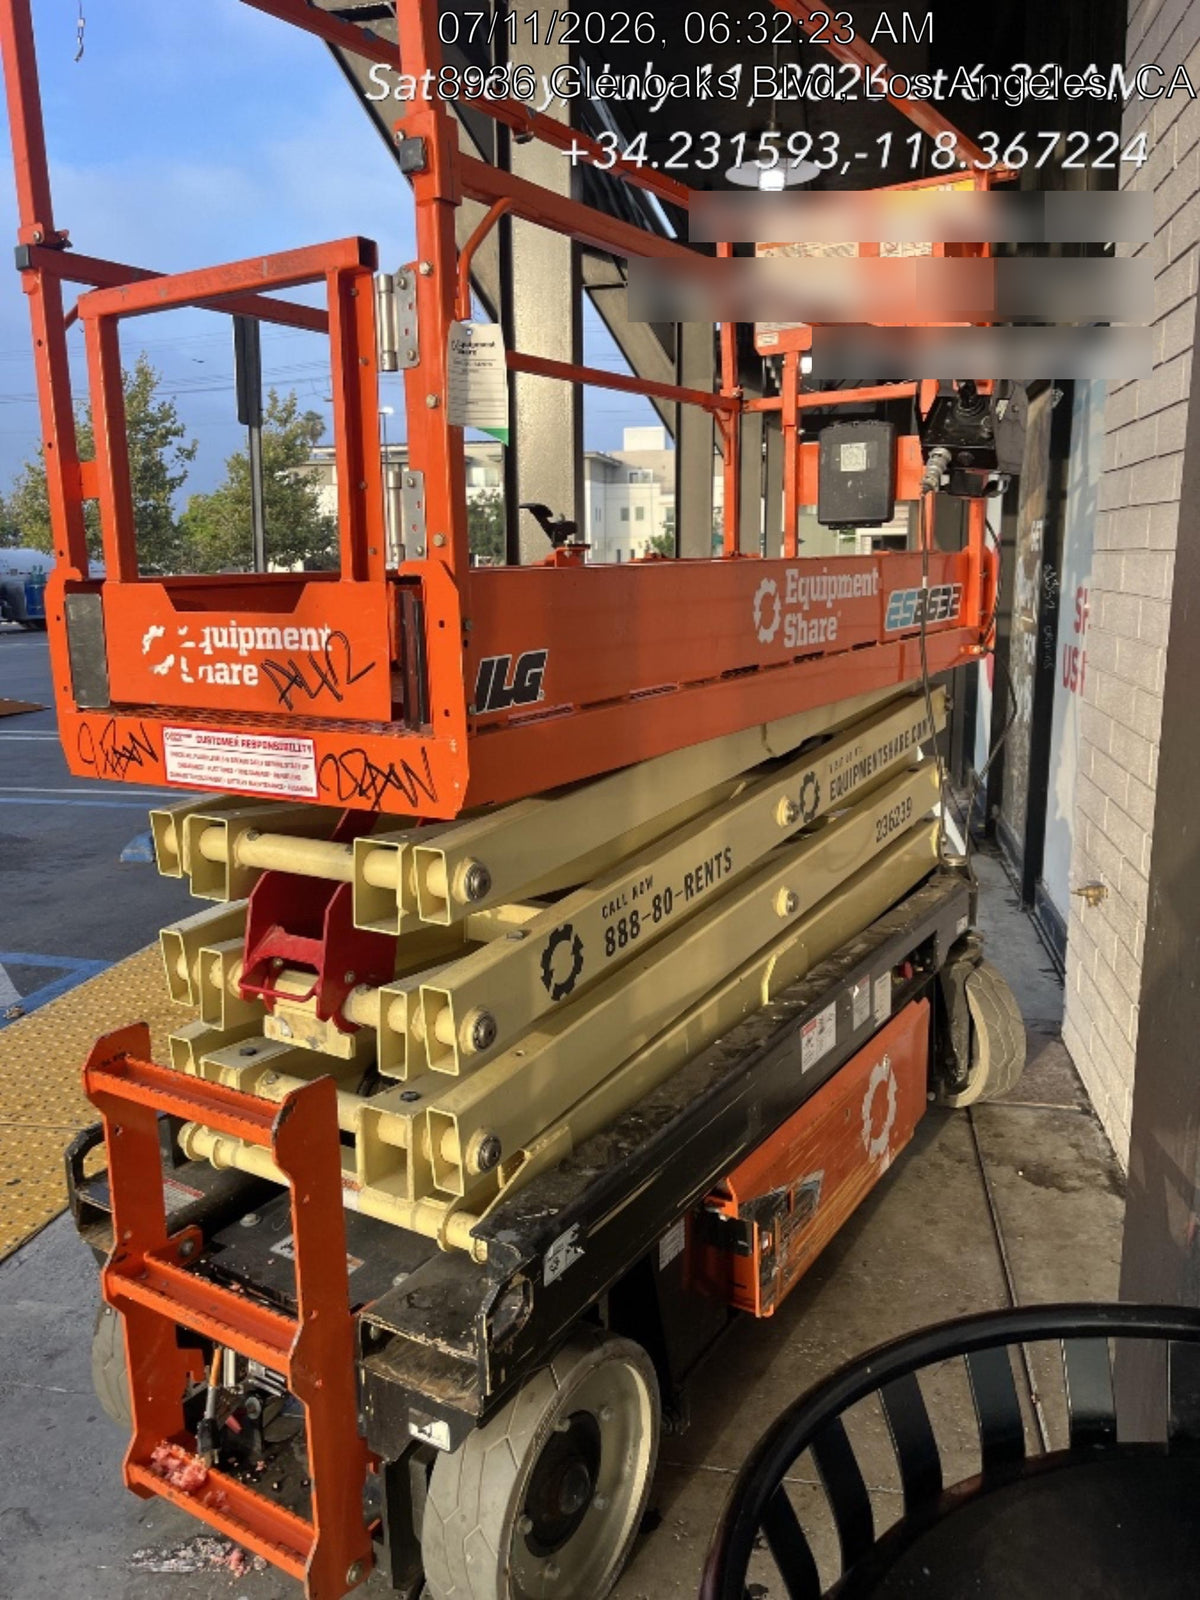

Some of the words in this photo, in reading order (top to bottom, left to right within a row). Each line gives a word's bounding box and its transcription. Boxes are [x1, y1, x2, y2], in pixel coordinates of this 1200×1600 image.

[785, 567, 879, 610] Equipment
[783, 613, 838, 648] Share
[474, 648, 548, 715] JLG
[195, 735, 240, 747] CUSTOMER
[875, 795, 912, 844] 236239
[601, 893, 629, 920] CALL
[604, 846, 732, 957] 888-80-RENTS
